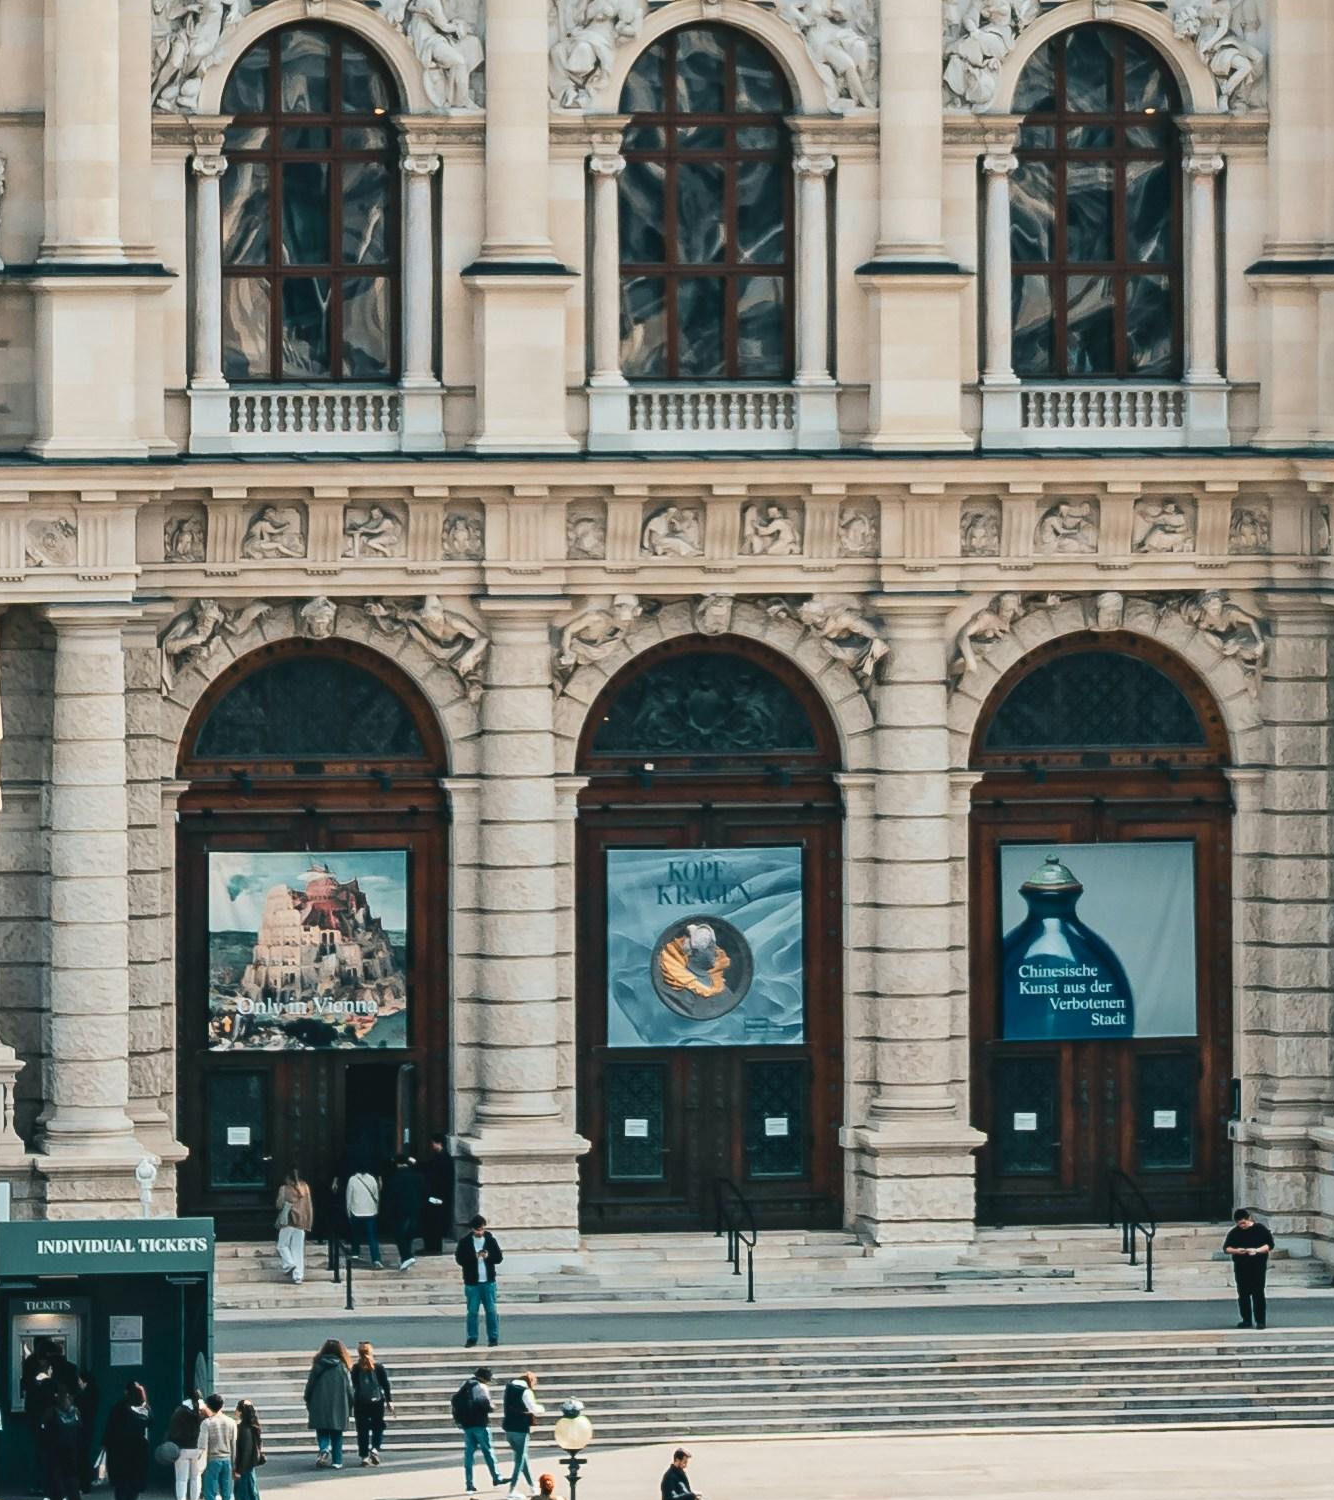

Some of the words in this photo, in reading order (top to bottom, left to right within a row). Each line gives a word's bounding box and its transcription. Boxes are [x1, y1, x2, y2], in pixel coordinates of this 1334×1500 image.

[669, 860, 726, 882] KOPF
[1018, 964, 1098, 978] Chinesische
[1019, 981, 1059, 994] Kunst
[1063, 983, 1086, 994] aus
[1090, 979, 1113, 993] der
[237, 997, 282, 1017] Only
[288, 997, 308, 1015] in
[313, 997, 378, 1014] Vienna
[1050, 997, 1126, 1010] Verbotenen
[1091, 1012, 1126, 1026] Stadt
[37, 1240, 136, 1255] INDIVIDUAL
[138, 1237, 208, 1252] TICKETS
[24, 1301, 71, 1311] TICKETS
